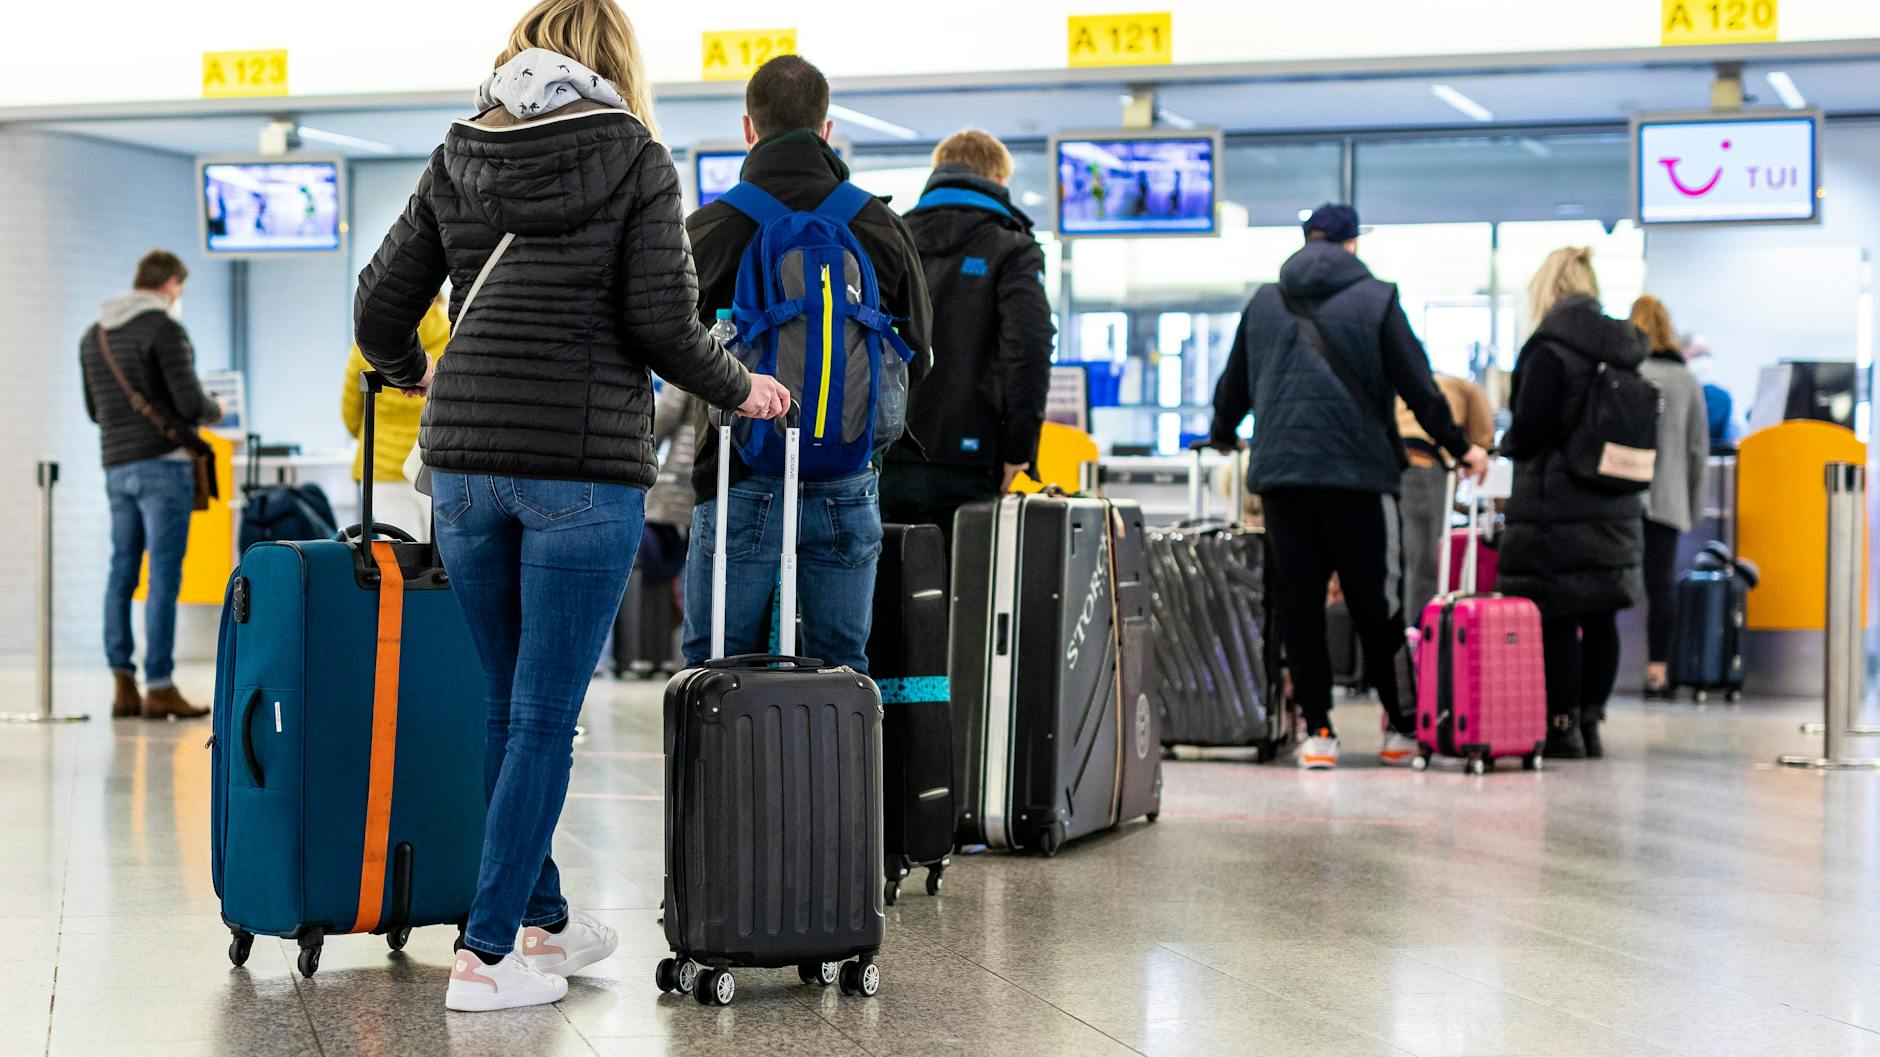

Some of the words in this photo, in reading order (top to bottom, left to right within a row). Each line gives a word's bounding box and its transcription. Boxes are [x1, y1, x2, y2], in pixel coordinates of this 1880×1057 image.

[1666, 2, 1694, 32] A
[1705, 0, 1773, 31] 120
[704, 37, 728, 67] A
[1070, 25, 1097, 55] A
[1105, 21, 1163, 53] 121
[203, 58, 225, 87] A
[235, 56, 287, 85] 123
[1746, 165, 1798, 190] TUI
